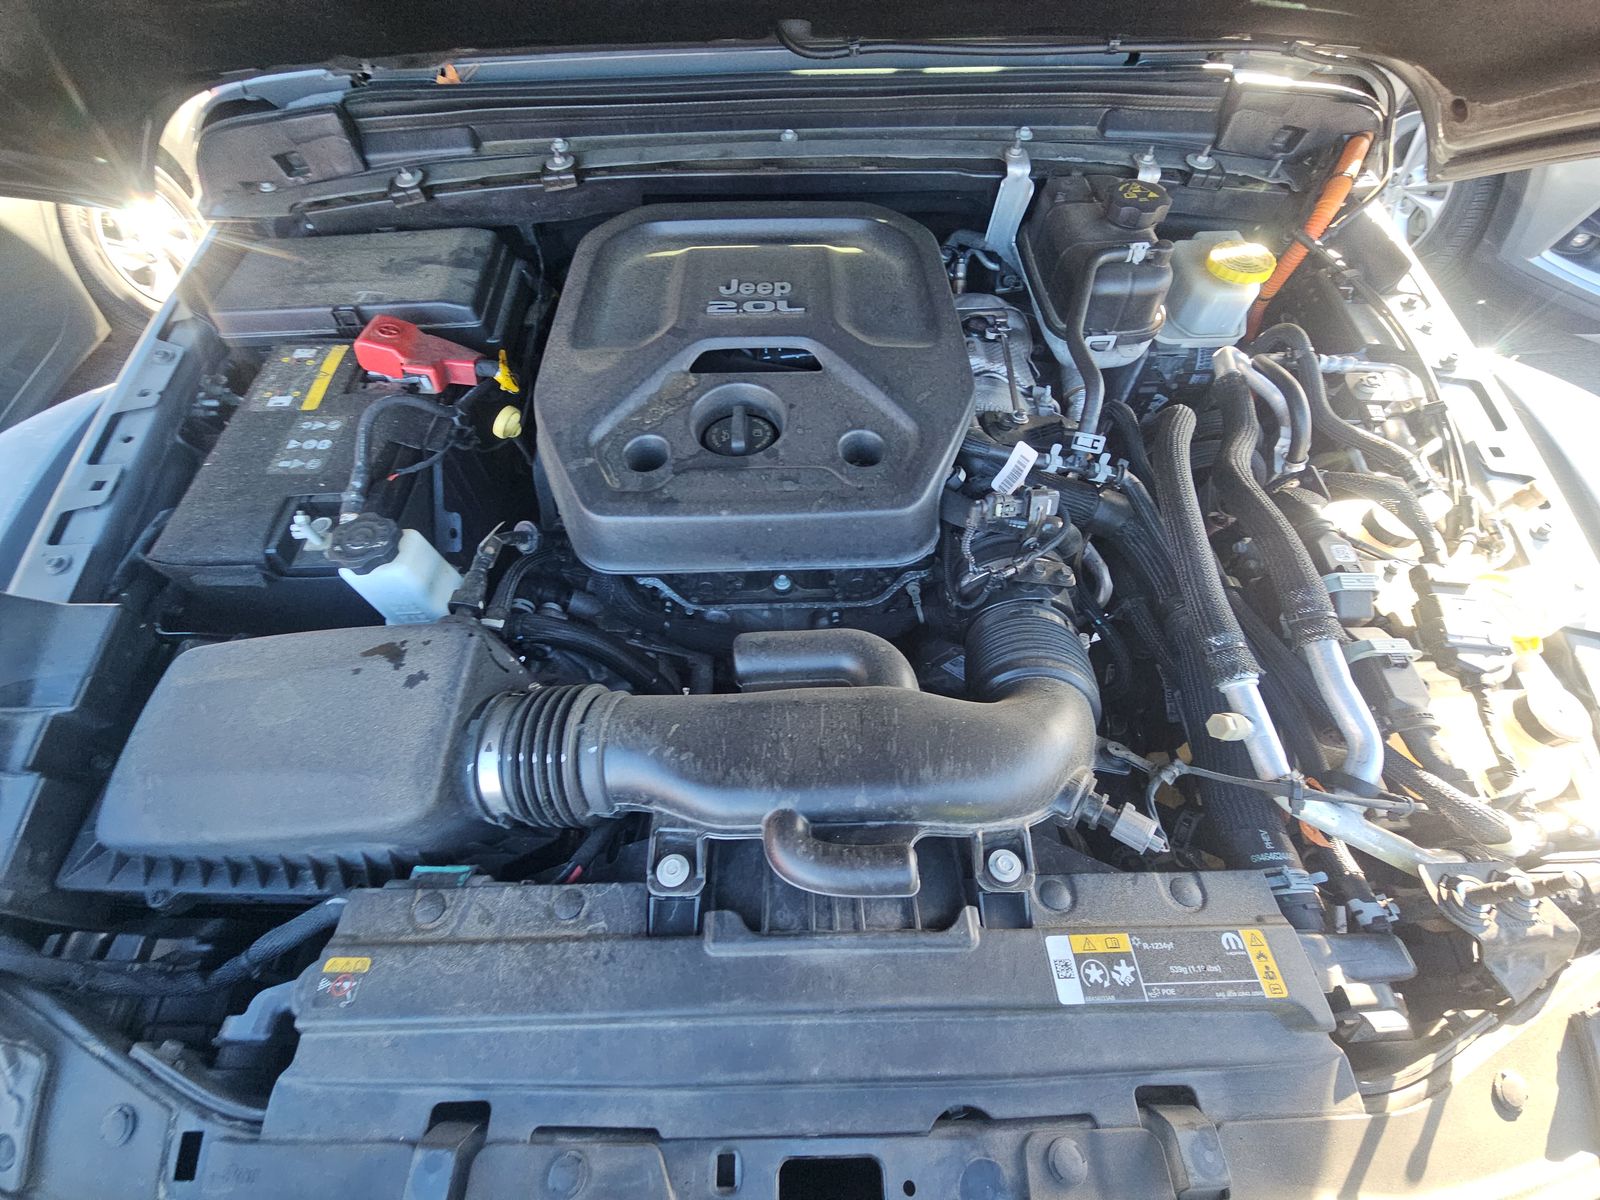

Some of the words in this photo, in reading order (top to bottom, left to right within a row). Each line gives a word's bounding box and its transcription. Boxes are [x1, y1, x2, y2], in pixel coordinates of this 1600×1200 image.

[718, 279, 792, 296] Jeep
[706, 300, 805, 313] 2.0L
[1161, 988, 1176, 996] POE
